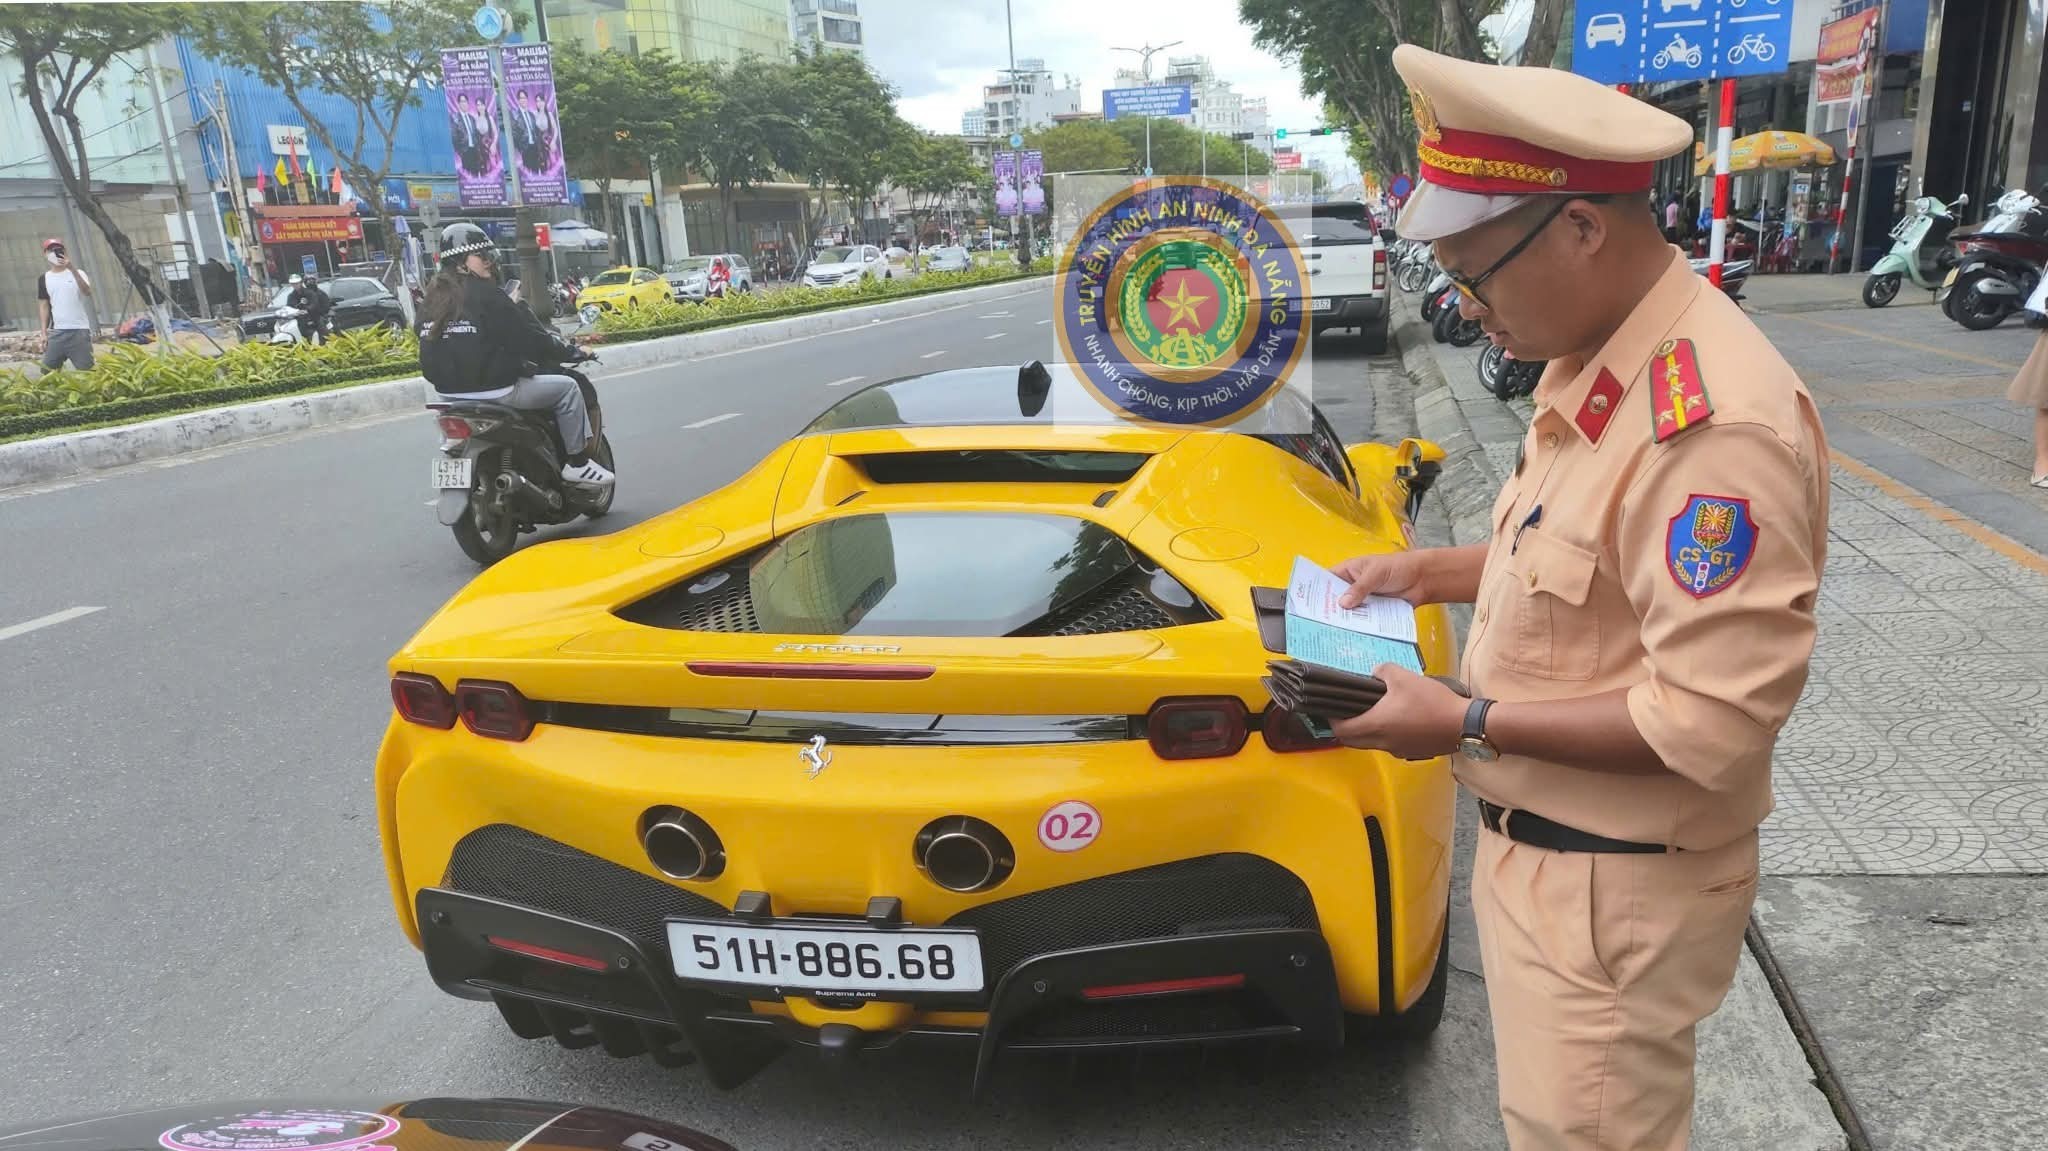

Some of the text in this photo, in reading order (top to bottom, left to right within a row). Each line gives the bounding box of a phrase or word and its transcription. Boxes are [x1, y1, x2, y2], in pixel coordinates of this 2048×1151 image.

[458, 51, 488, 60] MAILISA
[517, 46, 548, 56] MAILISA
[438, 474, 464, 487] 7254
[1679, 547, 1736, 567] CS GT
[1046, 812, 1094, 841] 02
[693, 934, 955, 980] 51H-886.68
